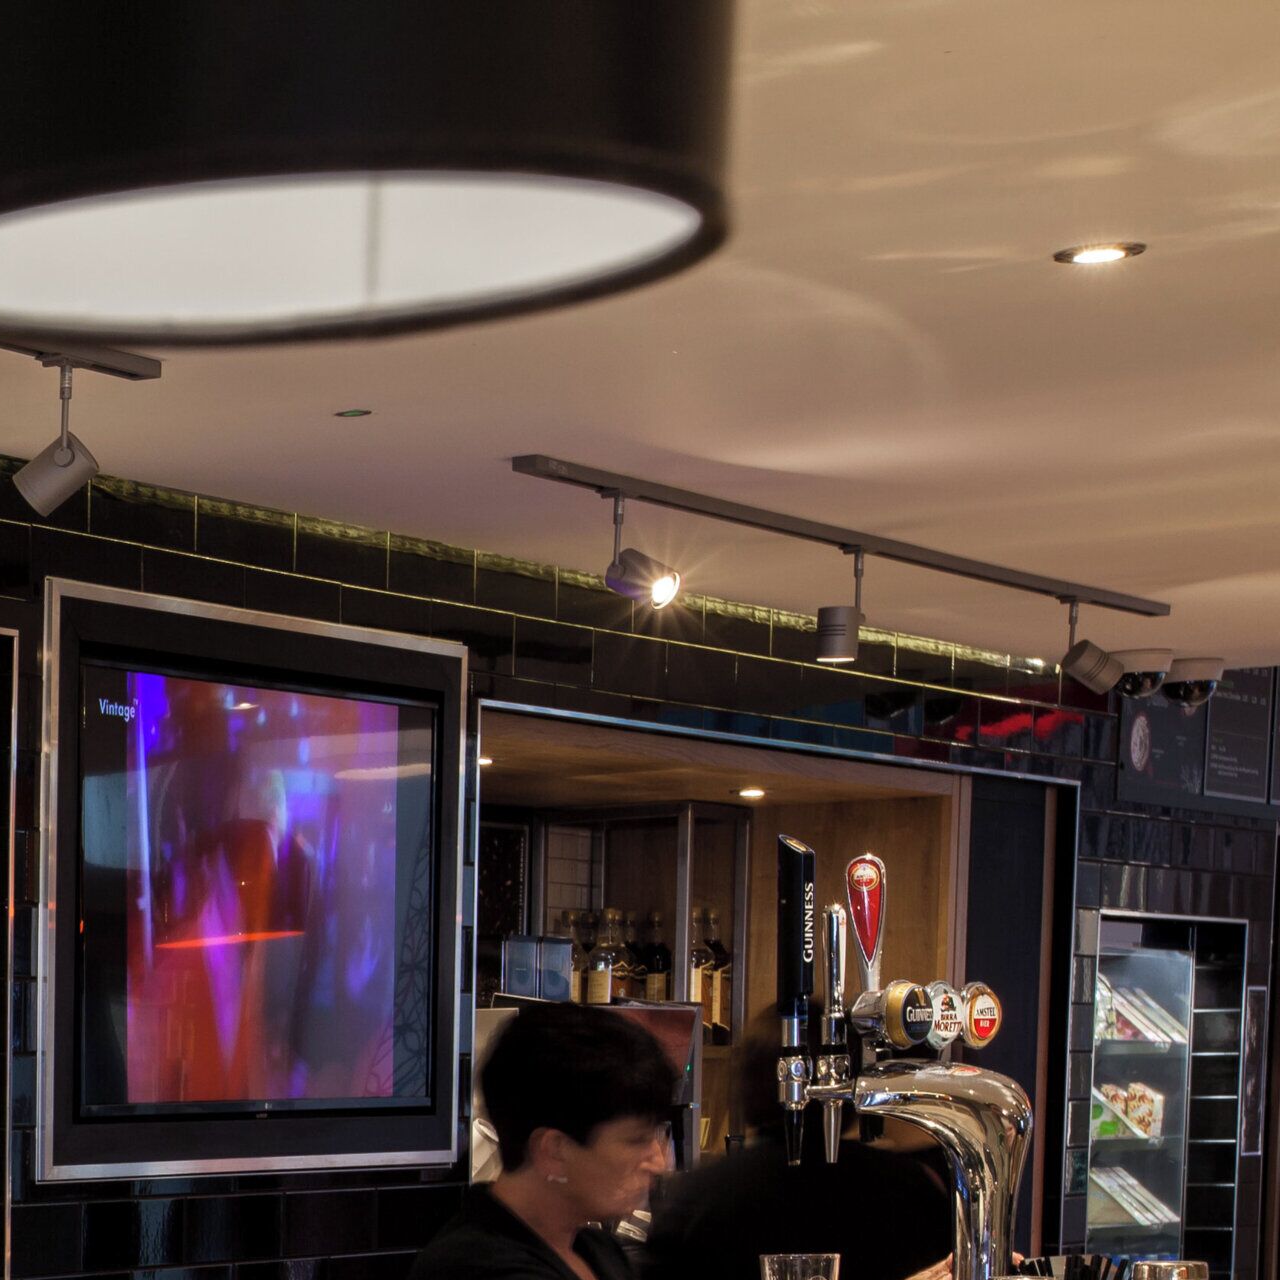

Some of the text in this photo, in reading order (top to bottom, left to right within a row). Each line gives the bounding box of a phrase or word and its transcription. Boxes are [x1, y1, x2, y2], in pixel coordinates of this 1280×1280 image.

[98, 698, 136, 722] Vintage
[803, 882, 814, 963] GUINNESS
[976, 1006, 996, 1017] AMSTEL
